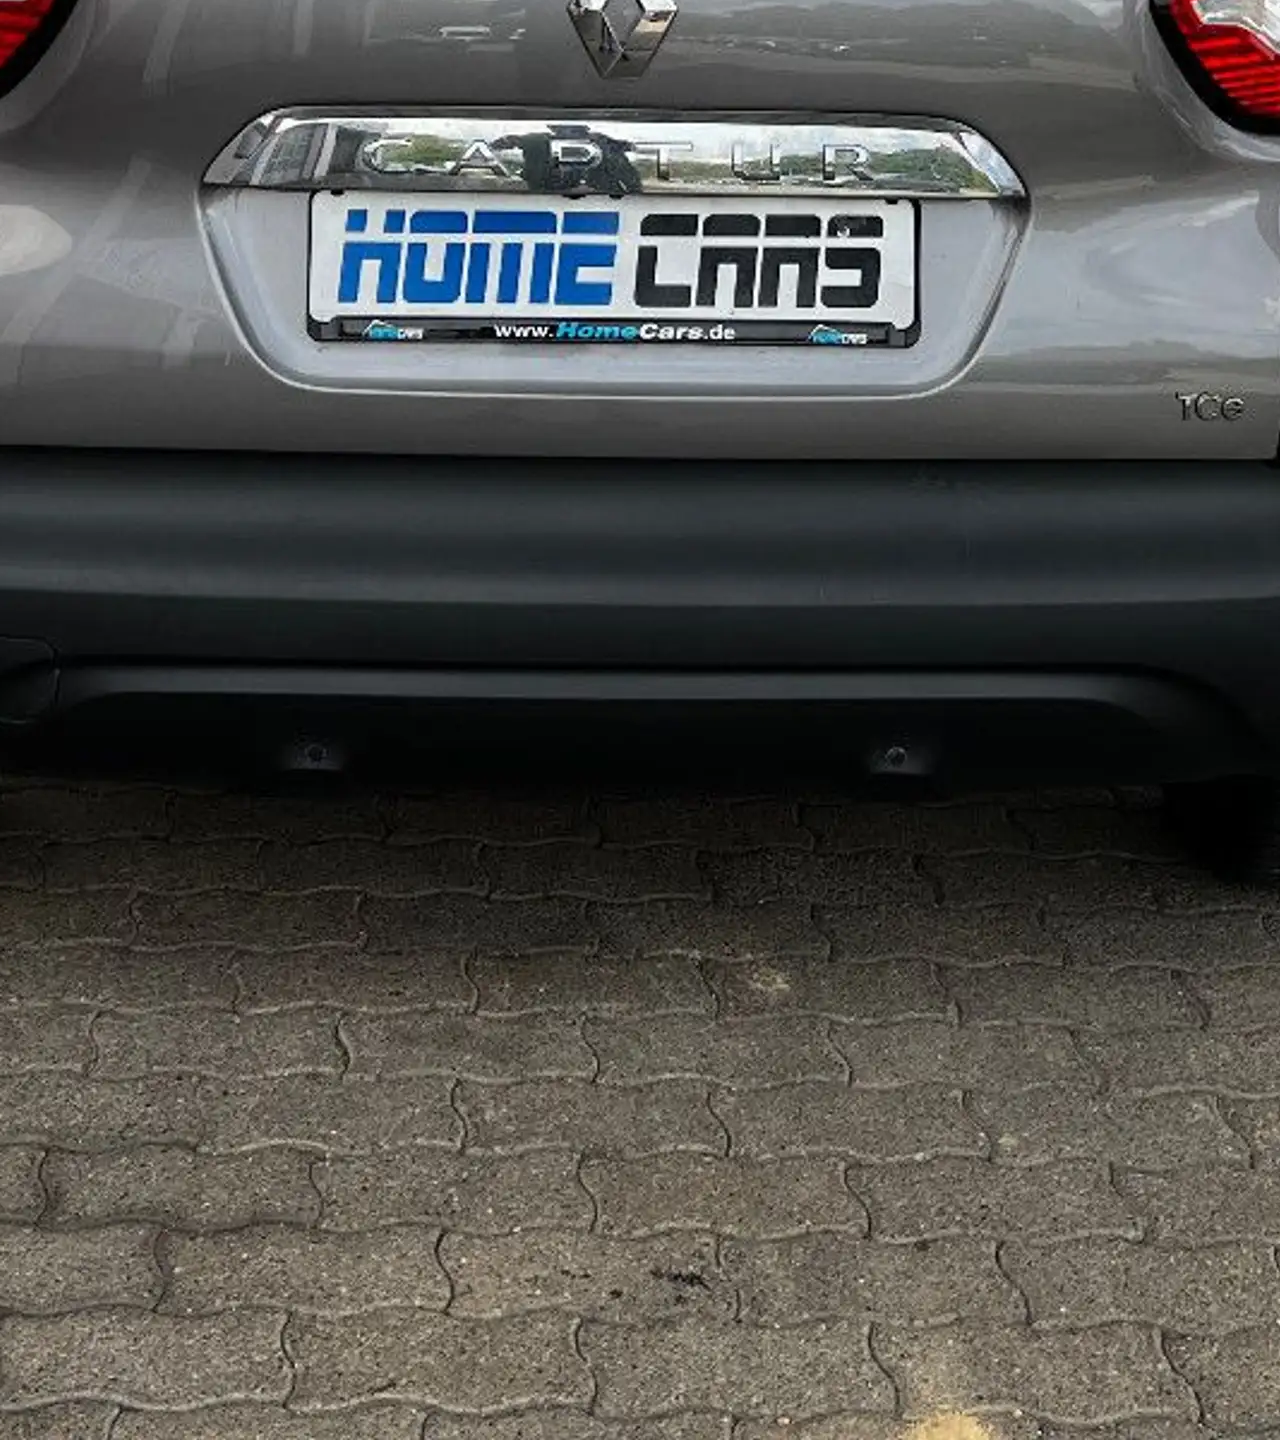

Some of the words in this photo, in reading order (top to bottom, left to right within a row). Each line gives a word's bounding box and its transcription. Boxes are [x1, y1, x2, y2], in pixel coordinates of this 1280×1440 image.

[361, 139, 874, 182] CAPTUR
[337, 208, 620, 304] HOME
[633, 213, 884, 309] CARS
[494, 320, 737, 340] www.HomeCars.de
